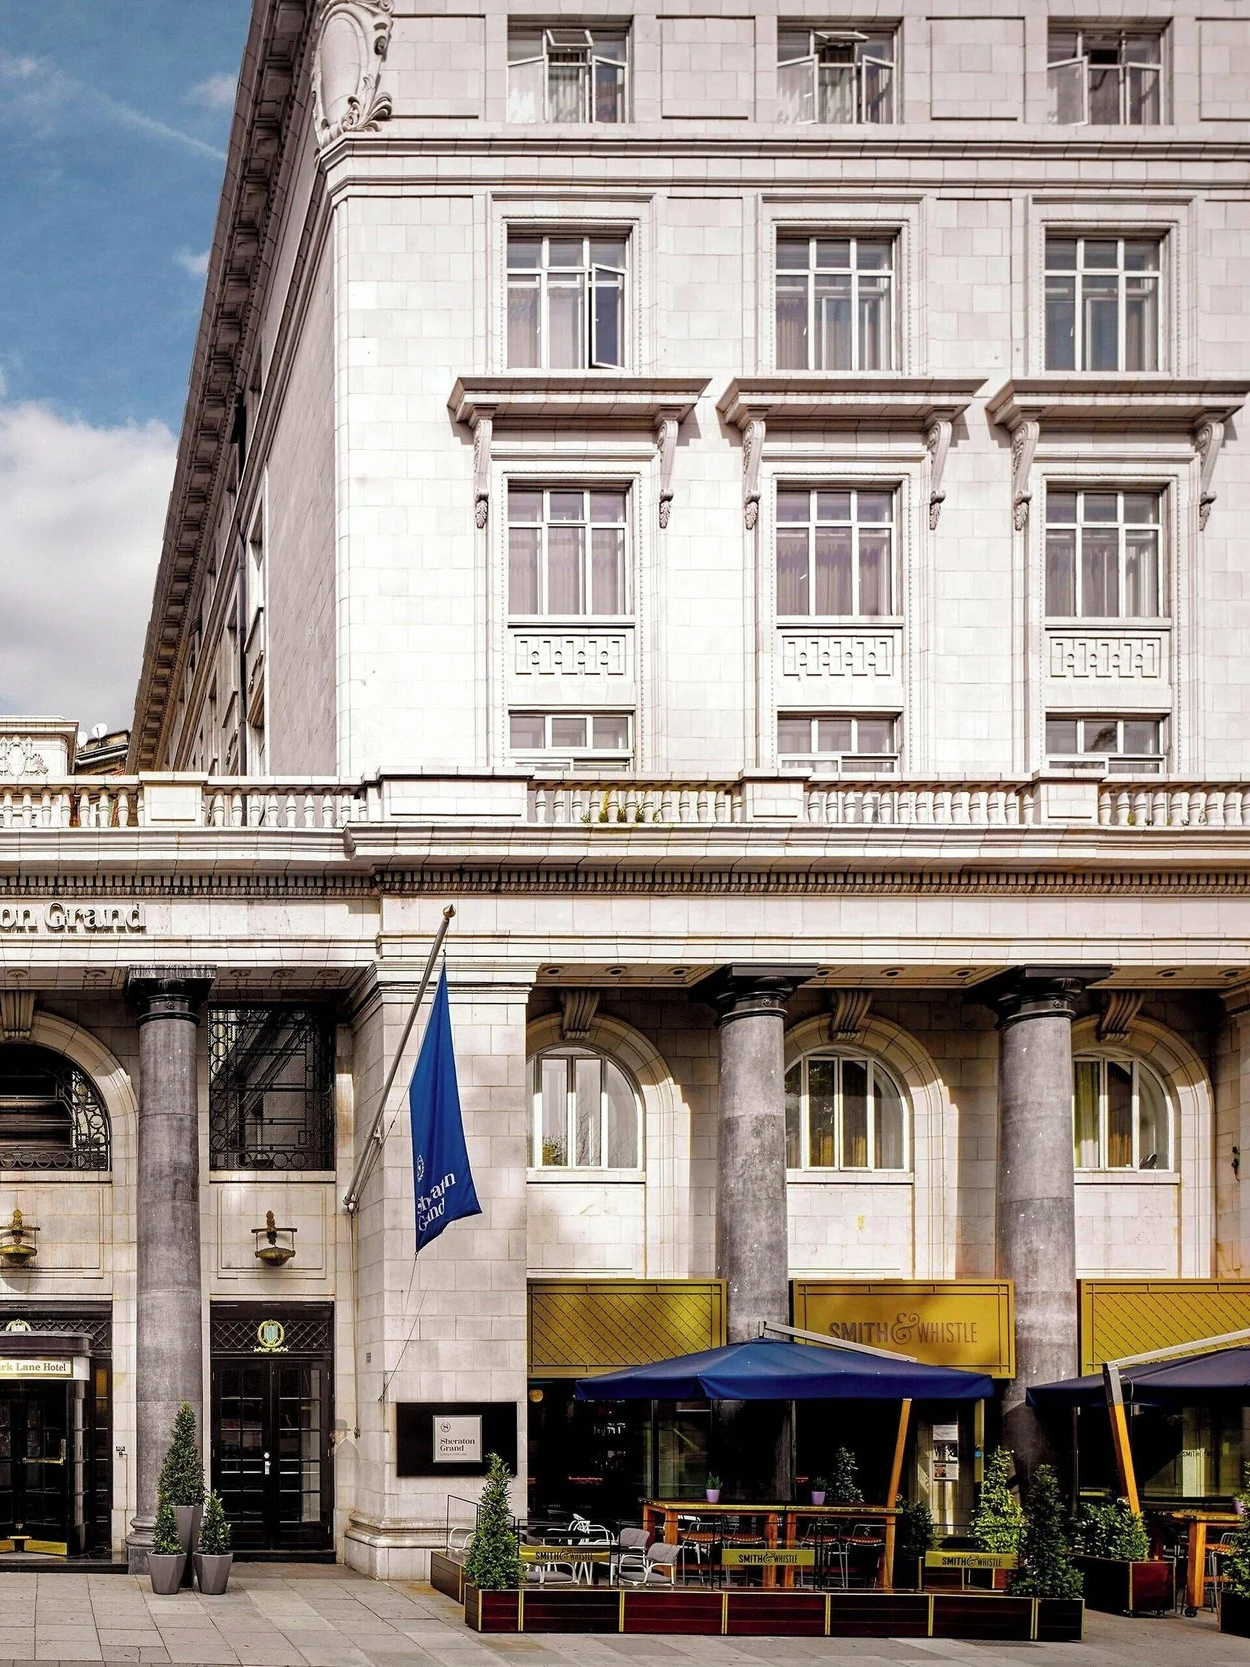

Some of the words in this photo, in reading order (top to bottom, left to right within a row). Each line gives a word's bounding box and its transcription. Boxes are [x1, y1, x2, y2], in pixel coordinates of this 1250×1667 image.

[45, 901, 147, 931] Grand
[829, 1322, 889, 1344] SMITH
[891, 1312, 920, 1345] &
[918, 1322, 978, 1343] WHISTLE
[16, 1362, 41, 1372] Lane
[43, 1362, 66, 1372] Hotel
[535, 1552, 559, 1560] SMITH
[570, 1552, 593, 1561] WHISTLE
[739, 1554, 763, 1563] SMITH
[763, 1551, 776, 1564] &
[774, 1555, 798, 1564] WHISTLE
[942, 1557, 967, 1566] SMITH
[967, 1554, 979, 1567] &
[978, 1558, 1002, 1567] WHISTLE
